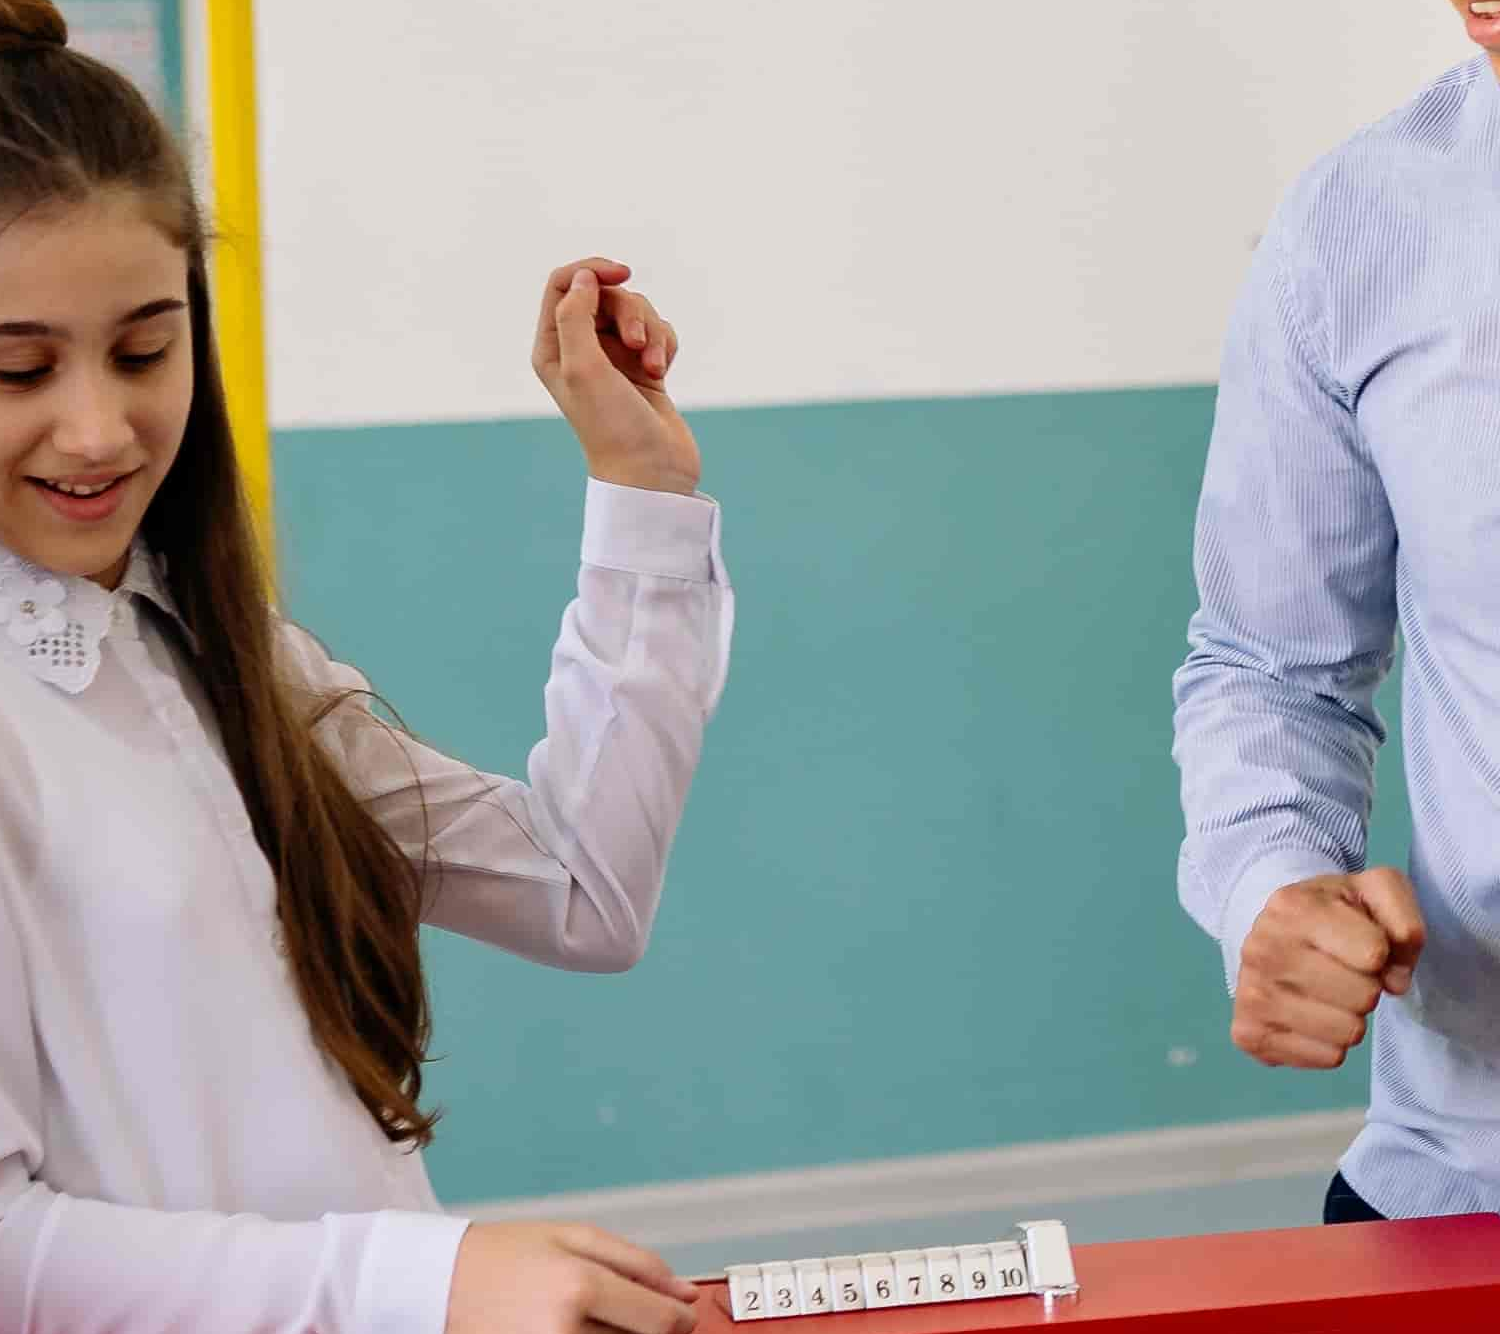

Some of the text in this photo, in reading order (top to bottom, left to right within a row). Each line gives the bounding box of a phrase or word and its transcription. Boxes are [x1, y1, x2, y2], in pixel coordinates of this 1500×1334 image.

[745, 1267, 1023, 1312] 2 3 4 5 6 7 8 9 10
